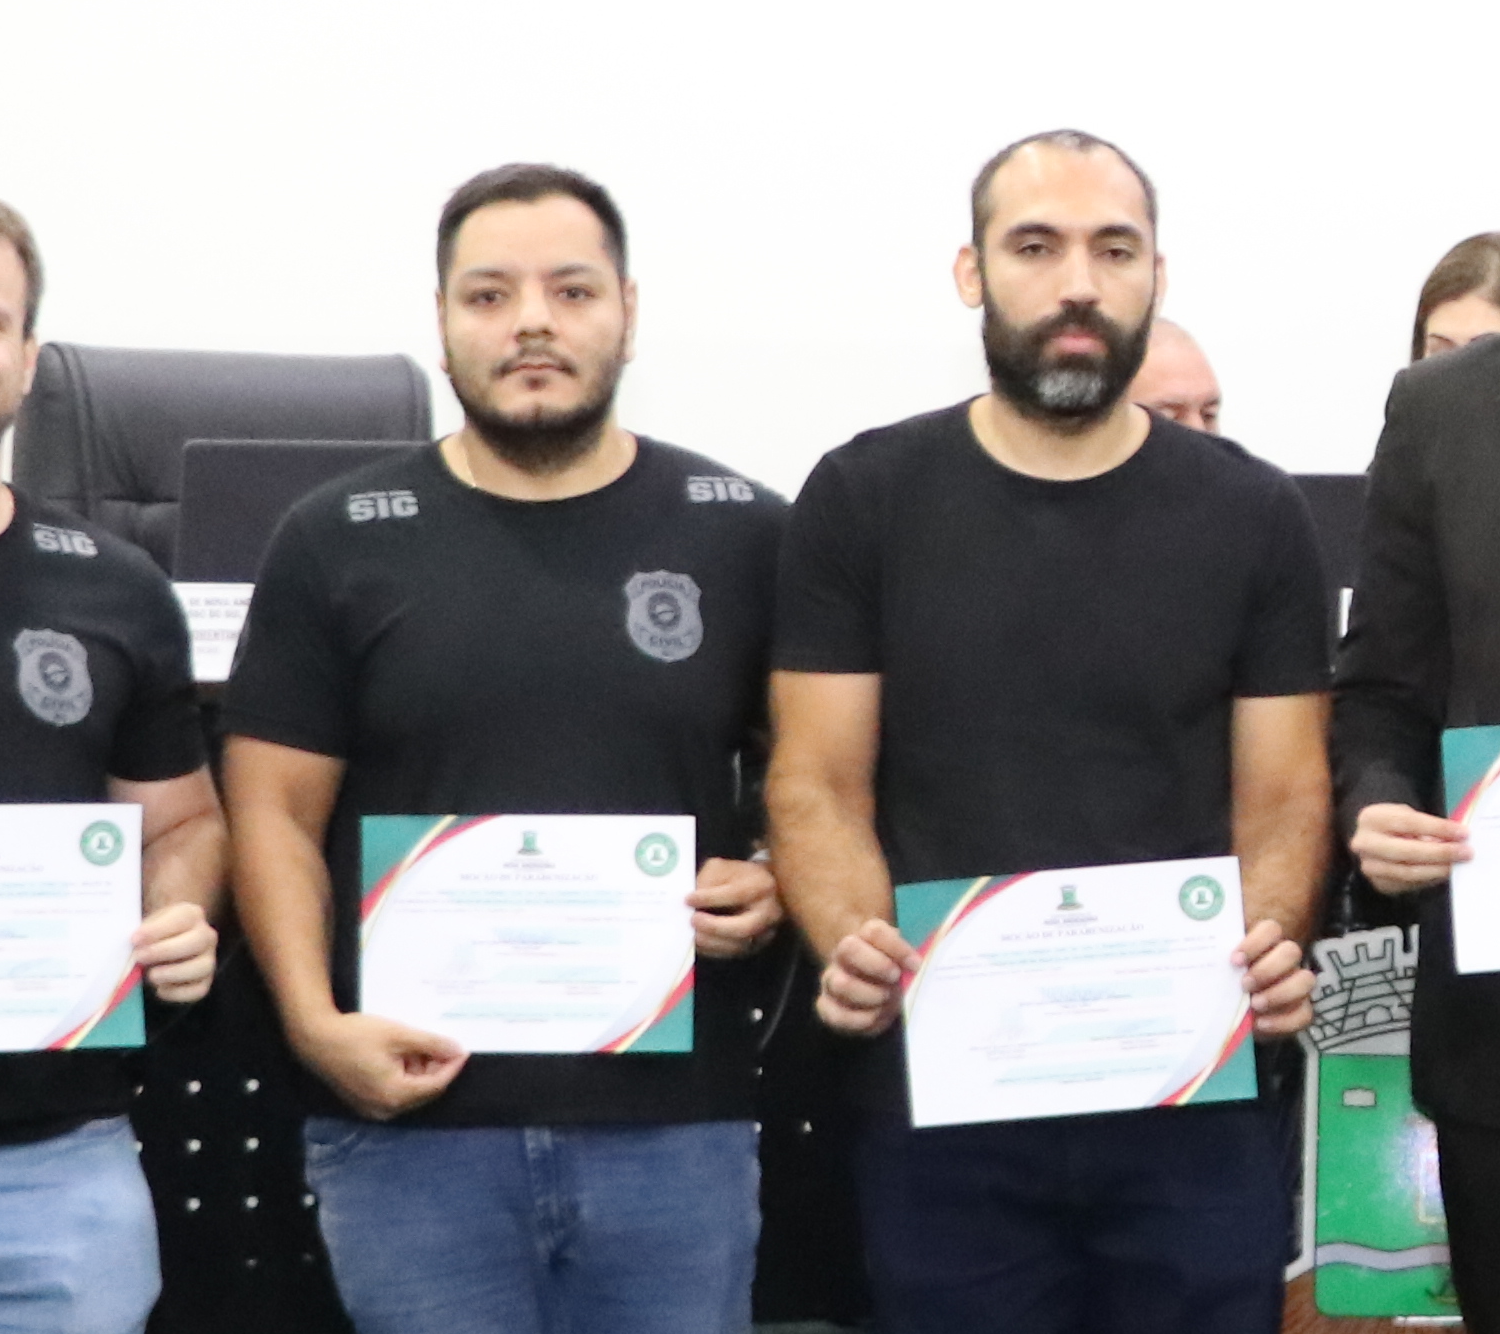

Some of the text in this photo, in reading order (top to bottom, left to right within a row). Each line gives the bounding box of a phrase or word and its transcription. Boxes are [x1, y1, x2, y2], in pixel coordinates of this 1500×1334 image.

[687, 479, 754, 503] SIG
[348, 494, 419, 523] SIG
[34, 528, 99, 559] SIG
